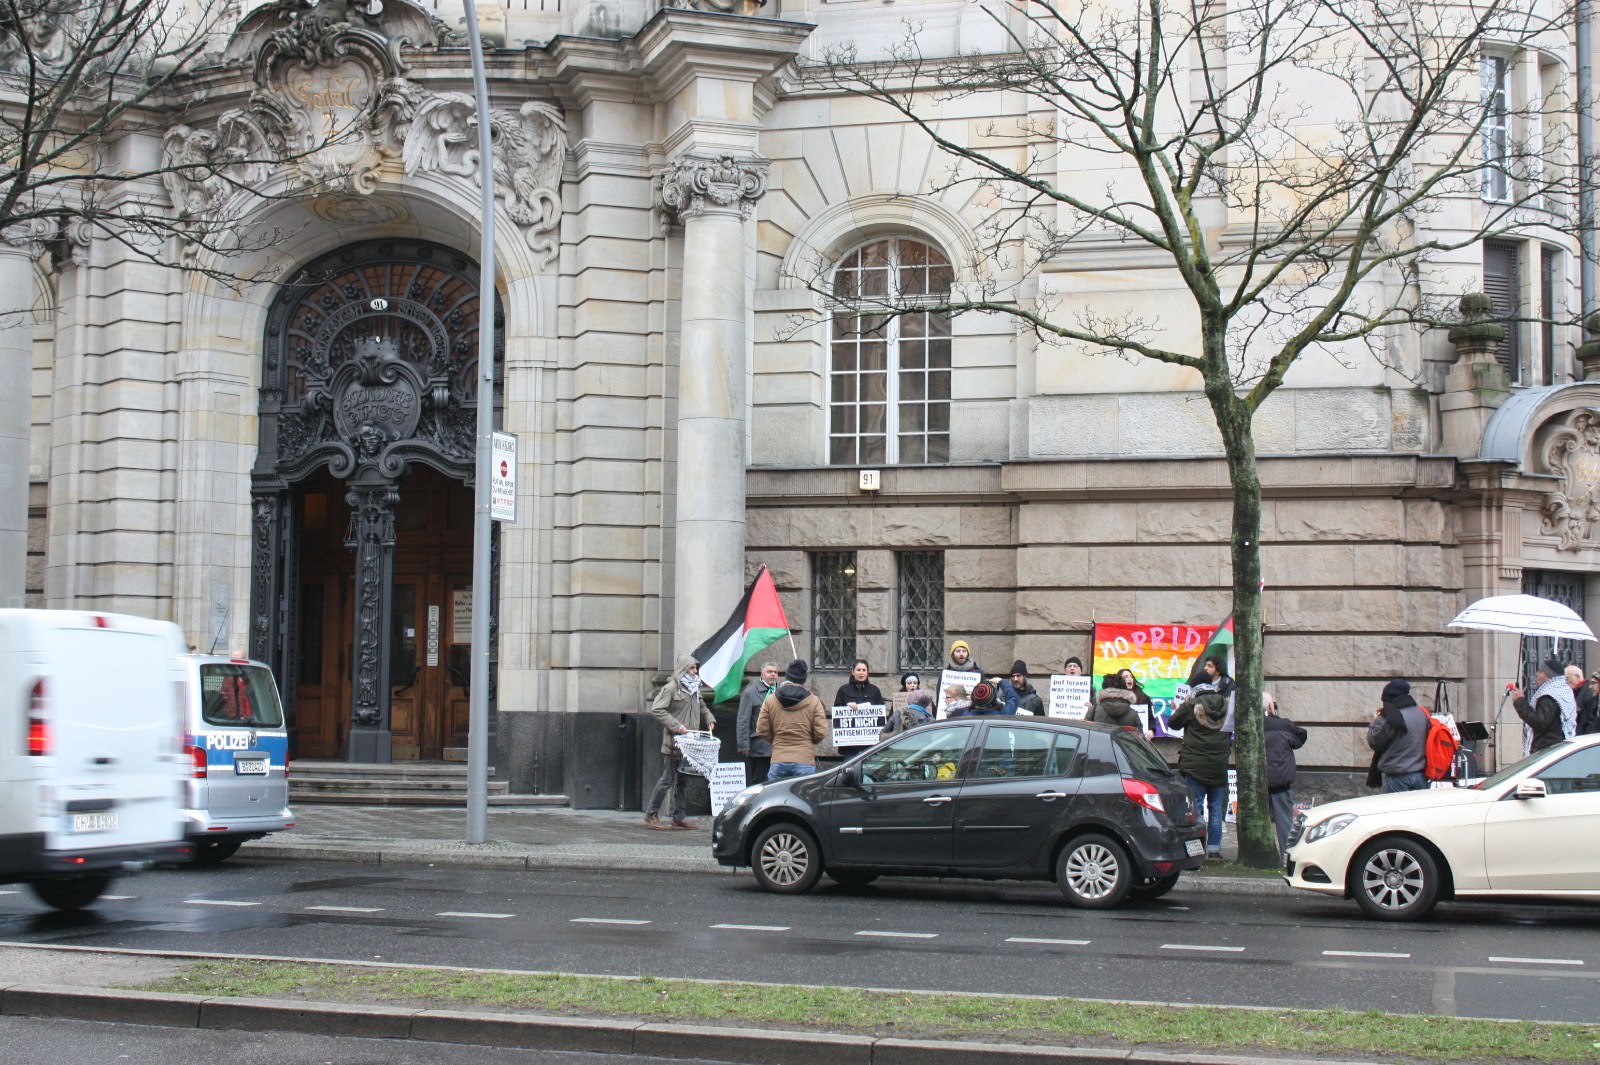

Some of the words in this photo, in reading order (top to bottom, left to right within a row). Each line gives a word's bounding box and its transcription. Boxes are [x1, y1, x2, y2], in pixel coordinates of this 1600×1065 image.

[863, 473, 873, 485] 91
[1131, 625, 1214, 656] PRID
[834, 708, 883, 717] ANTIZIONISMUS
[840, 717, 853, 728] IST
[854, 716, 879, 727] NICHT
[206, 733, 249, 750] POLIZEI
